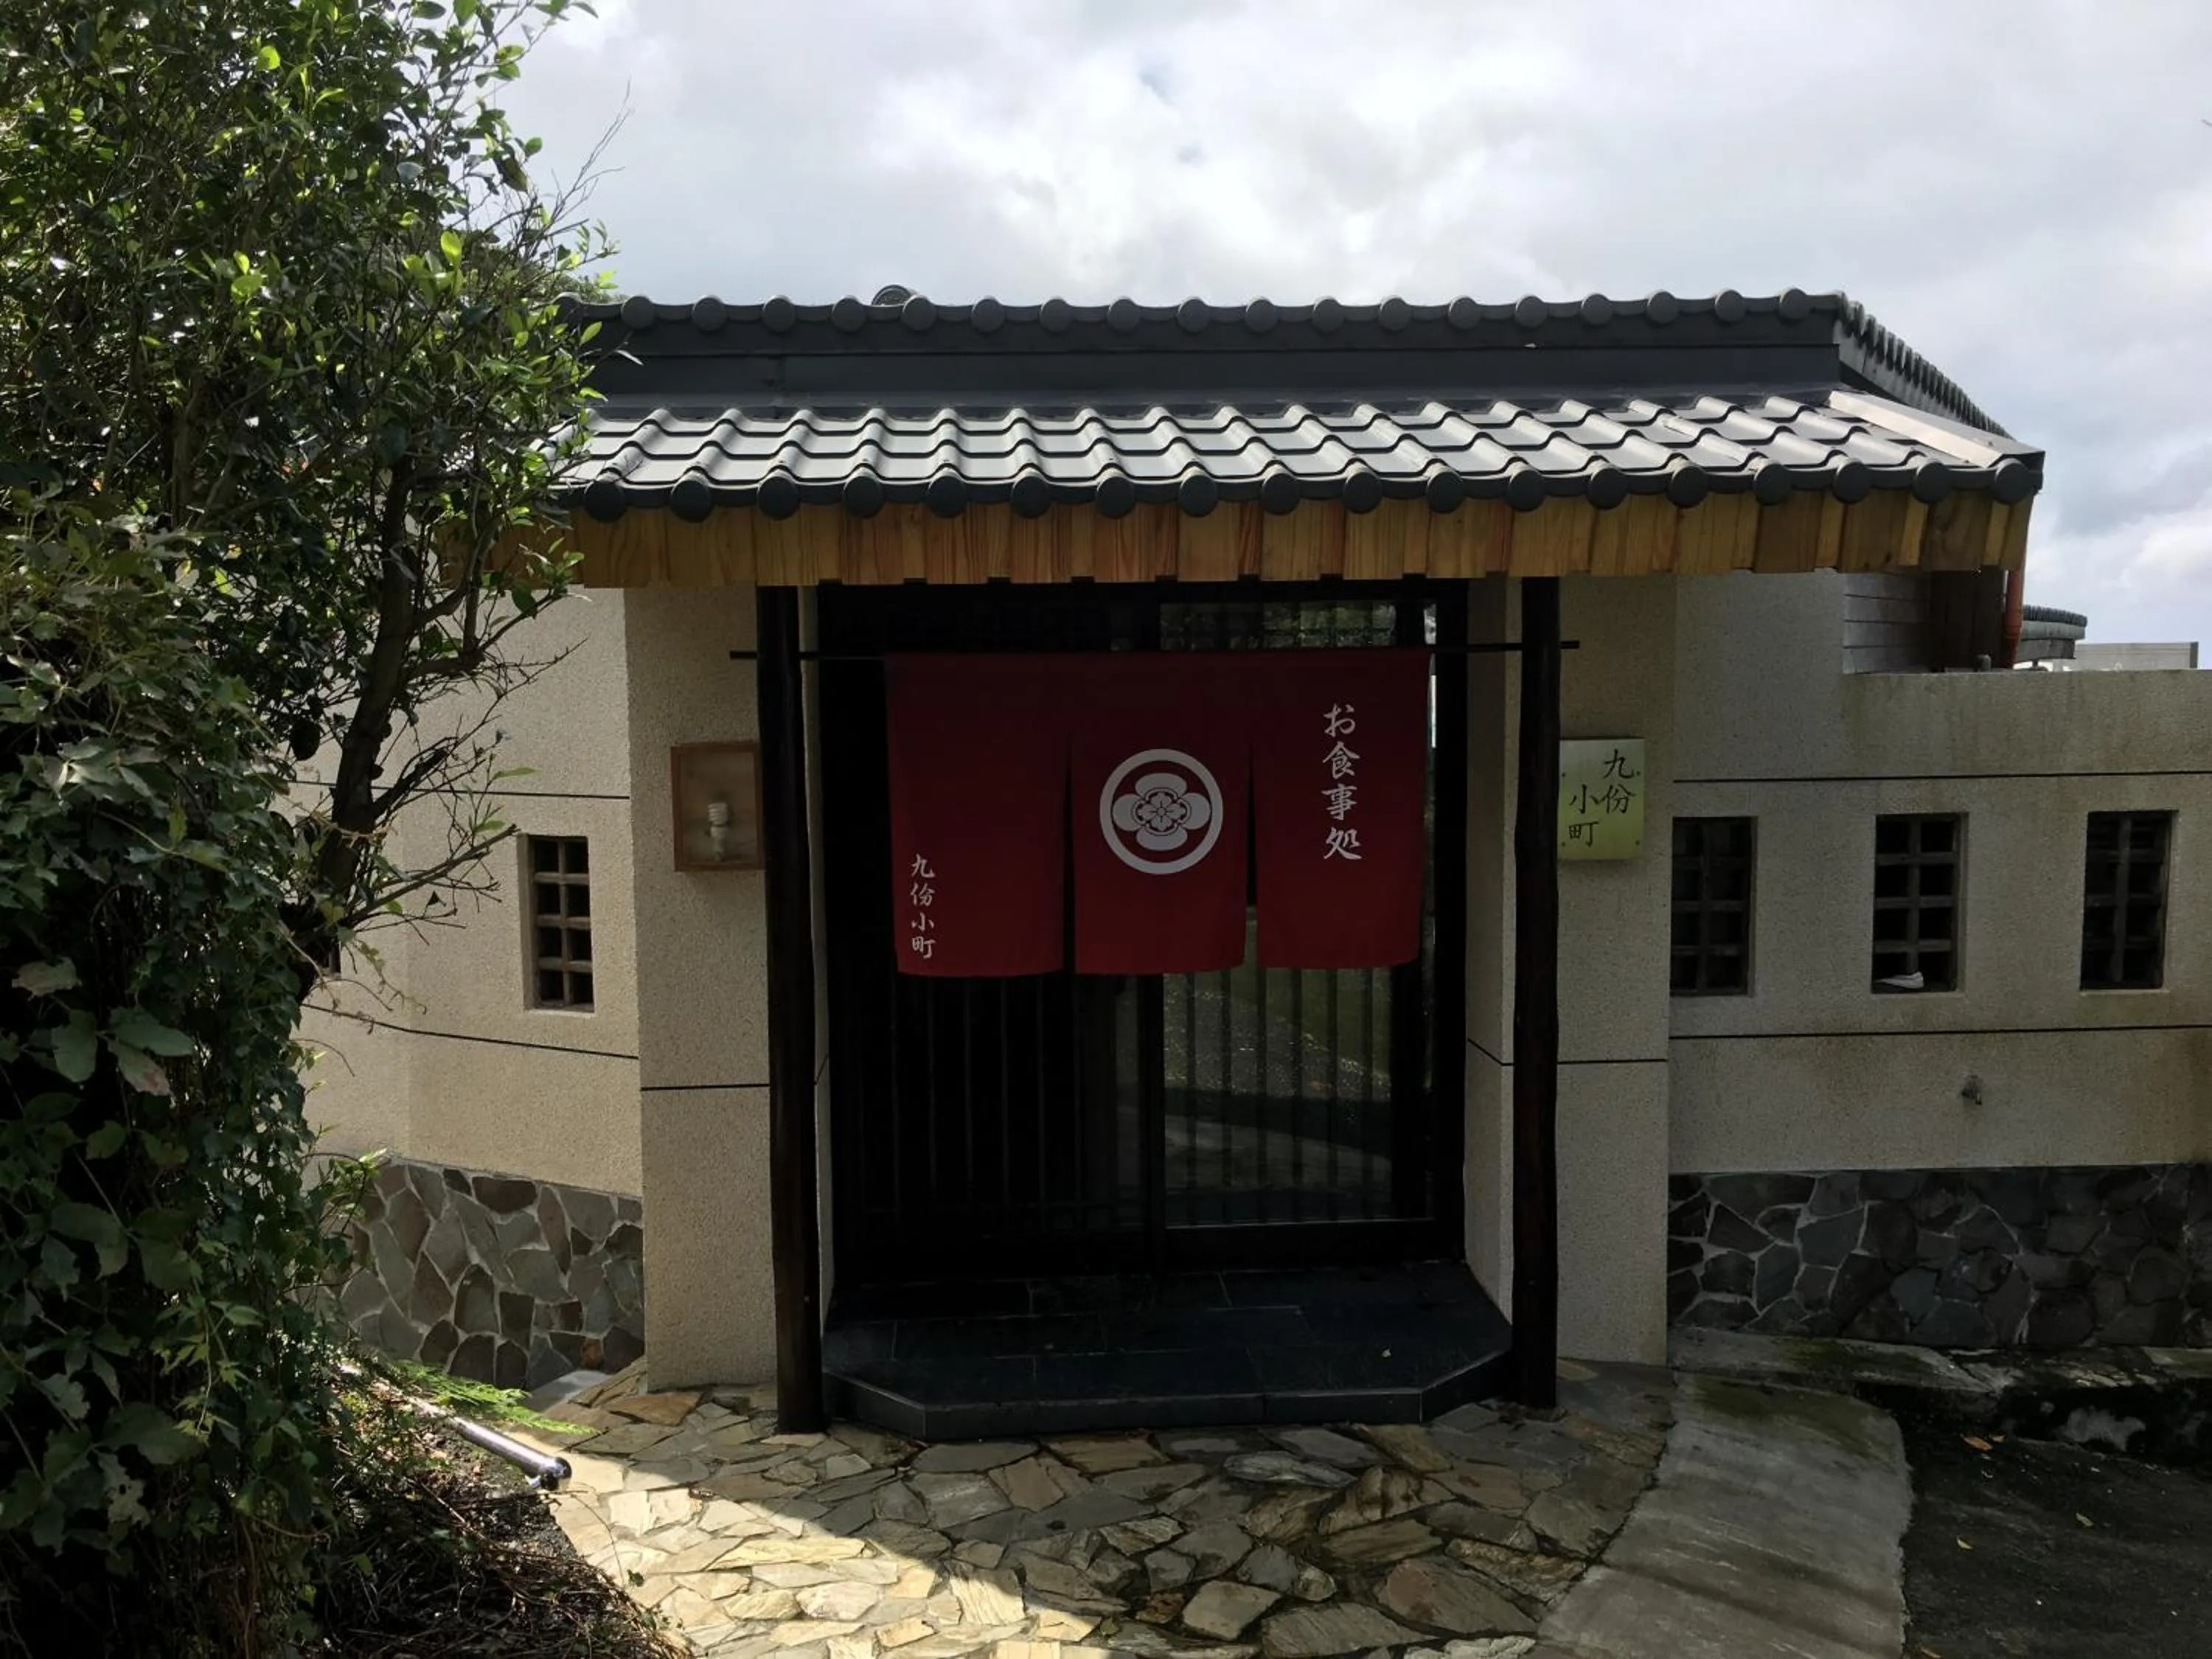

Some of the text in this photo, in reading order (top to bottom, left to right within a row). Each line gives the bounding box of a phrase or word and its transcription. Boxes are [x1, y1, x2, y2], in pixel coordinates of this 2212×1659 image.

[1321, 703, 1363, 860] お食事処
[1568, 784, 1599, 848] 小町
[1602, 748, 1635, 814] 九份
[911, 853, 936, 959] 九份小町
